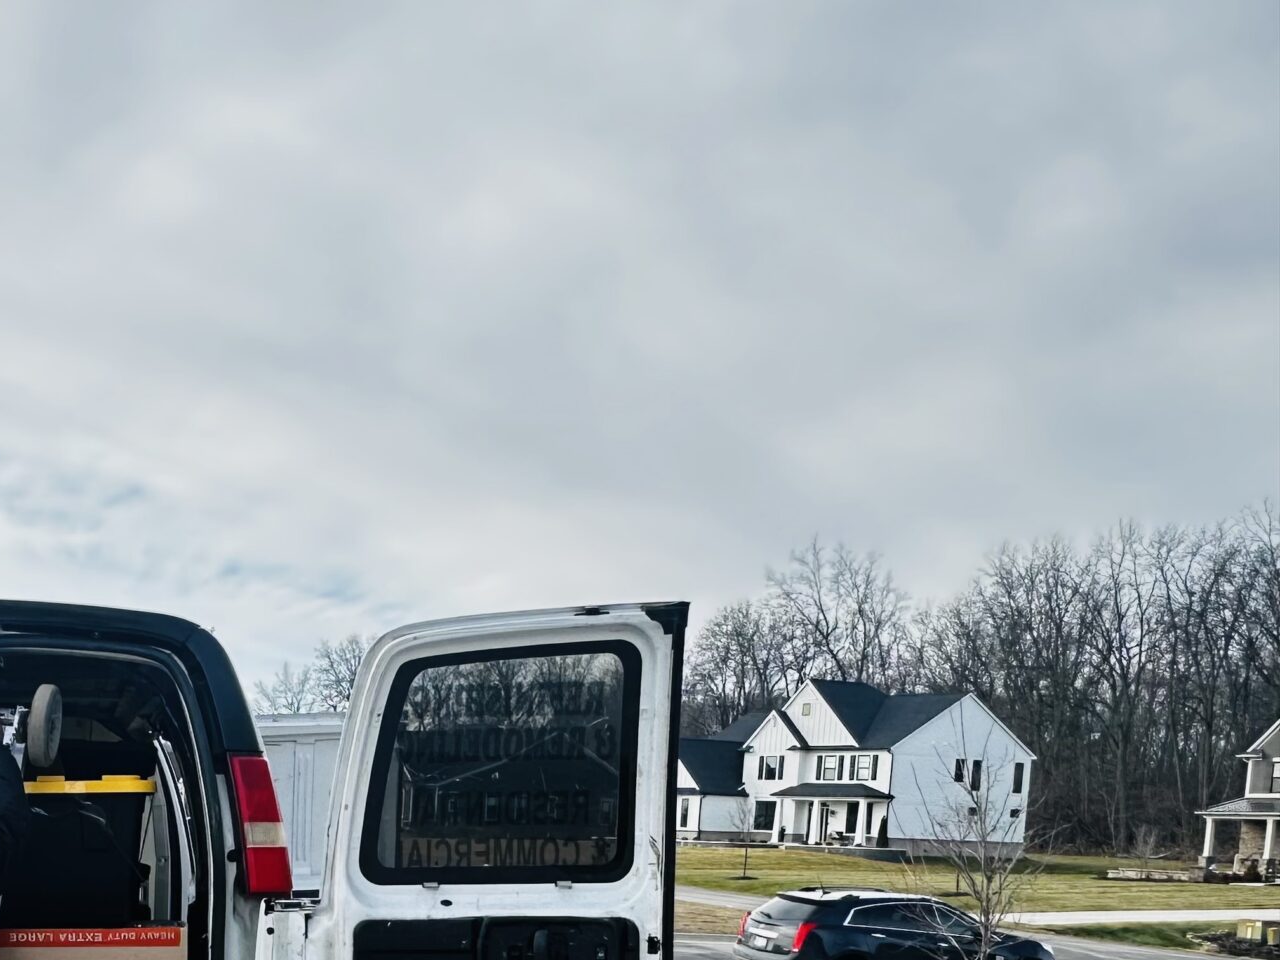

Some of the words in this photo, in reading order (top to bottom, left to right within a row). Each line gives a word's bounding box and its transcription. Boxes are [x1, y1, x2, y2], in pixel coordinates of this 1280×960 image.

[9, 932, 54, 943] LARGE
[60, 932, 104, 943] EXTRA
[107, 932, 137, 941] DUTY
[140, 931, 176, 940] HEAVY
